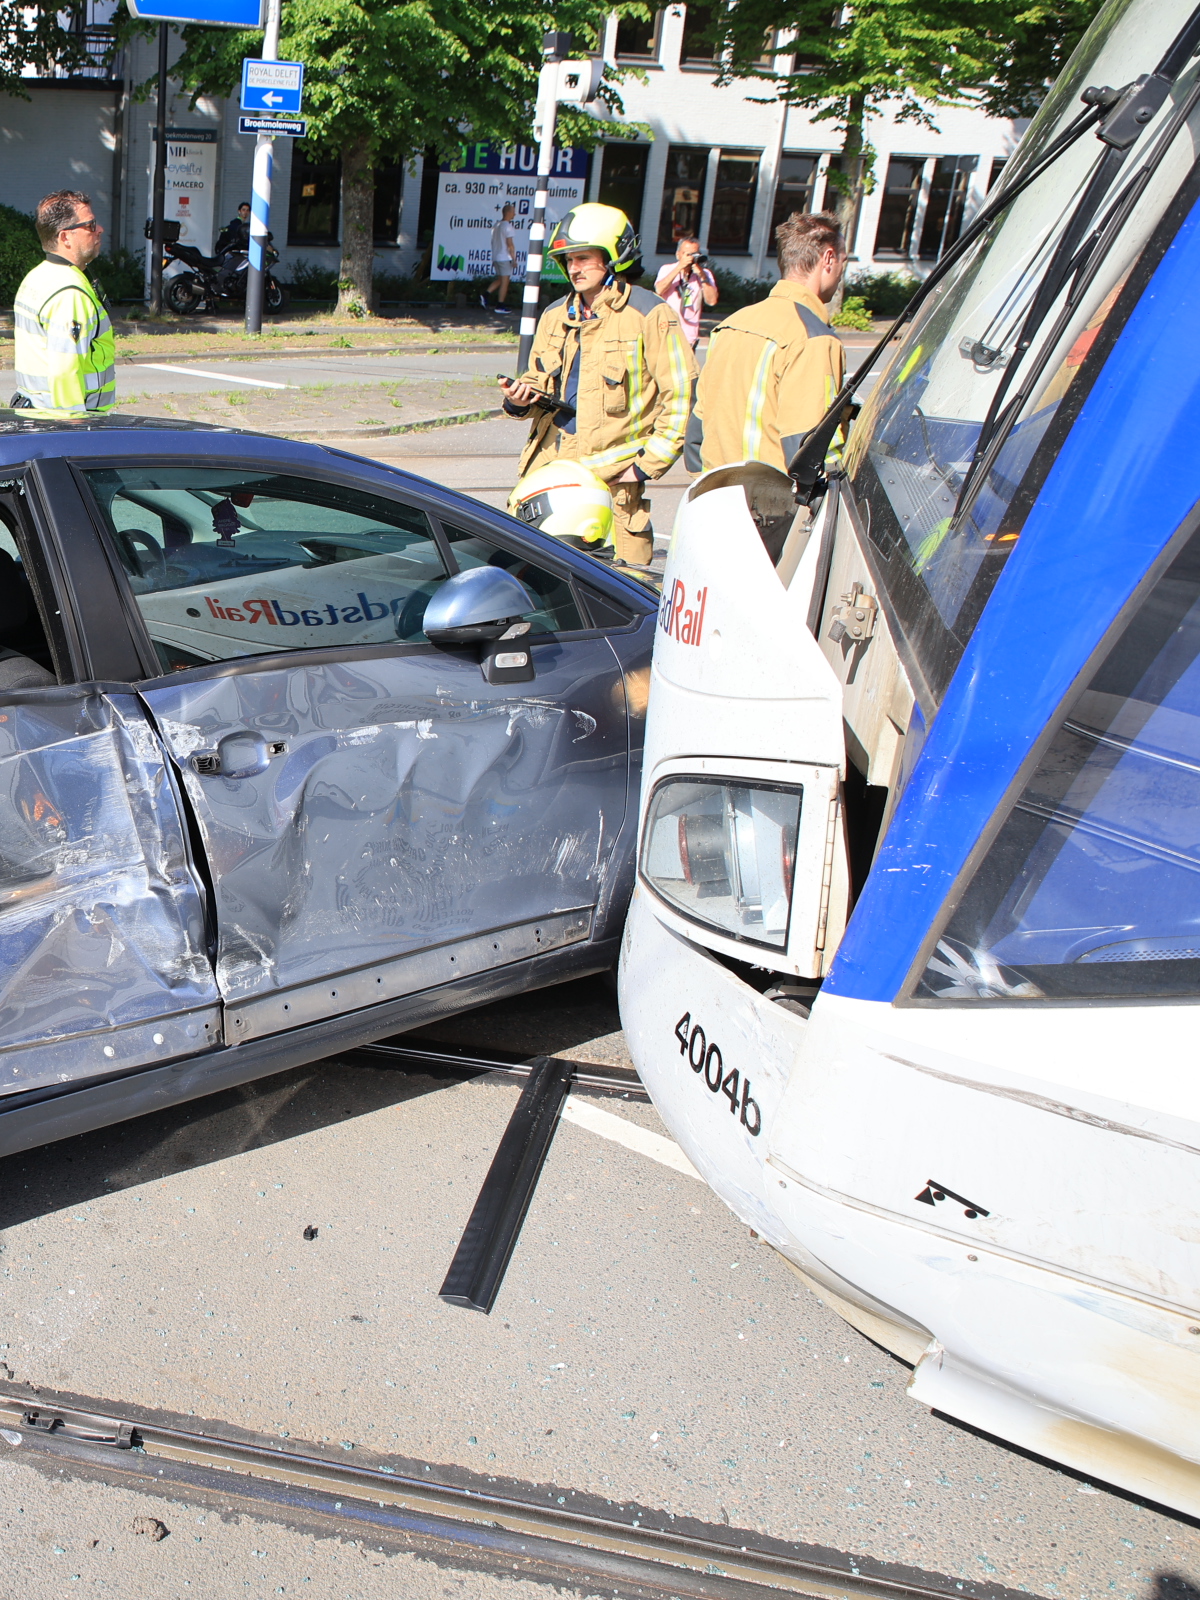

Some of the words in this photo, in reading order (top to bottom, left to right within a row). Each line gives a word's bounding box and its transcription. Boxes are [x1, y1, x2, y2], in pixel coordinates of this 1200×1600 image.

[249, 66, 273, 78] ROYAL
[274, 68, 299, 79] DELFT
[244, 118, 302, 131] Broekmolenweg
[172, 181, 204, 189] MACERO
[445, 182, 461, 194] ca.
[465, 182, 486, 195] 930
[449, 215, 463, 230] (in
[467, 216, 493, 229] units
[674, 1011, 761, 1137] 4004b
